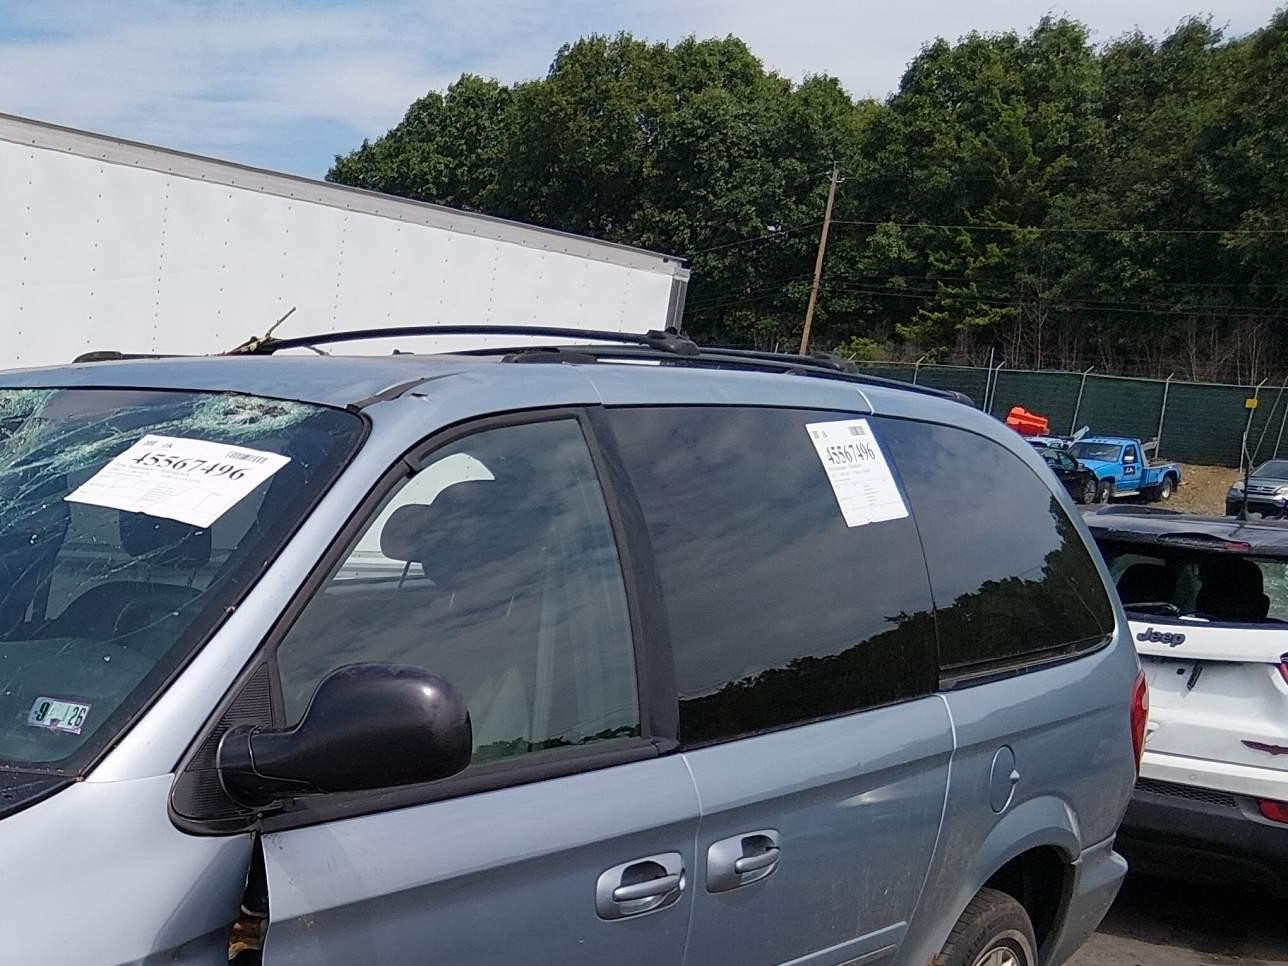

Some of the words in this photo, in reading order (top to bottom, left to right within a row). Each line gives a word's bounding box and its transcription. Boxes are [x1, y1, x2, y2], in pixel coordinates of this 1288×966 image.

[827, 441, 876, 464] 45567496
[132, 451, 246, 480] 45567496
[1137, 627, 1186, 648] Jeep
[68, 707, 86, 726] 26
